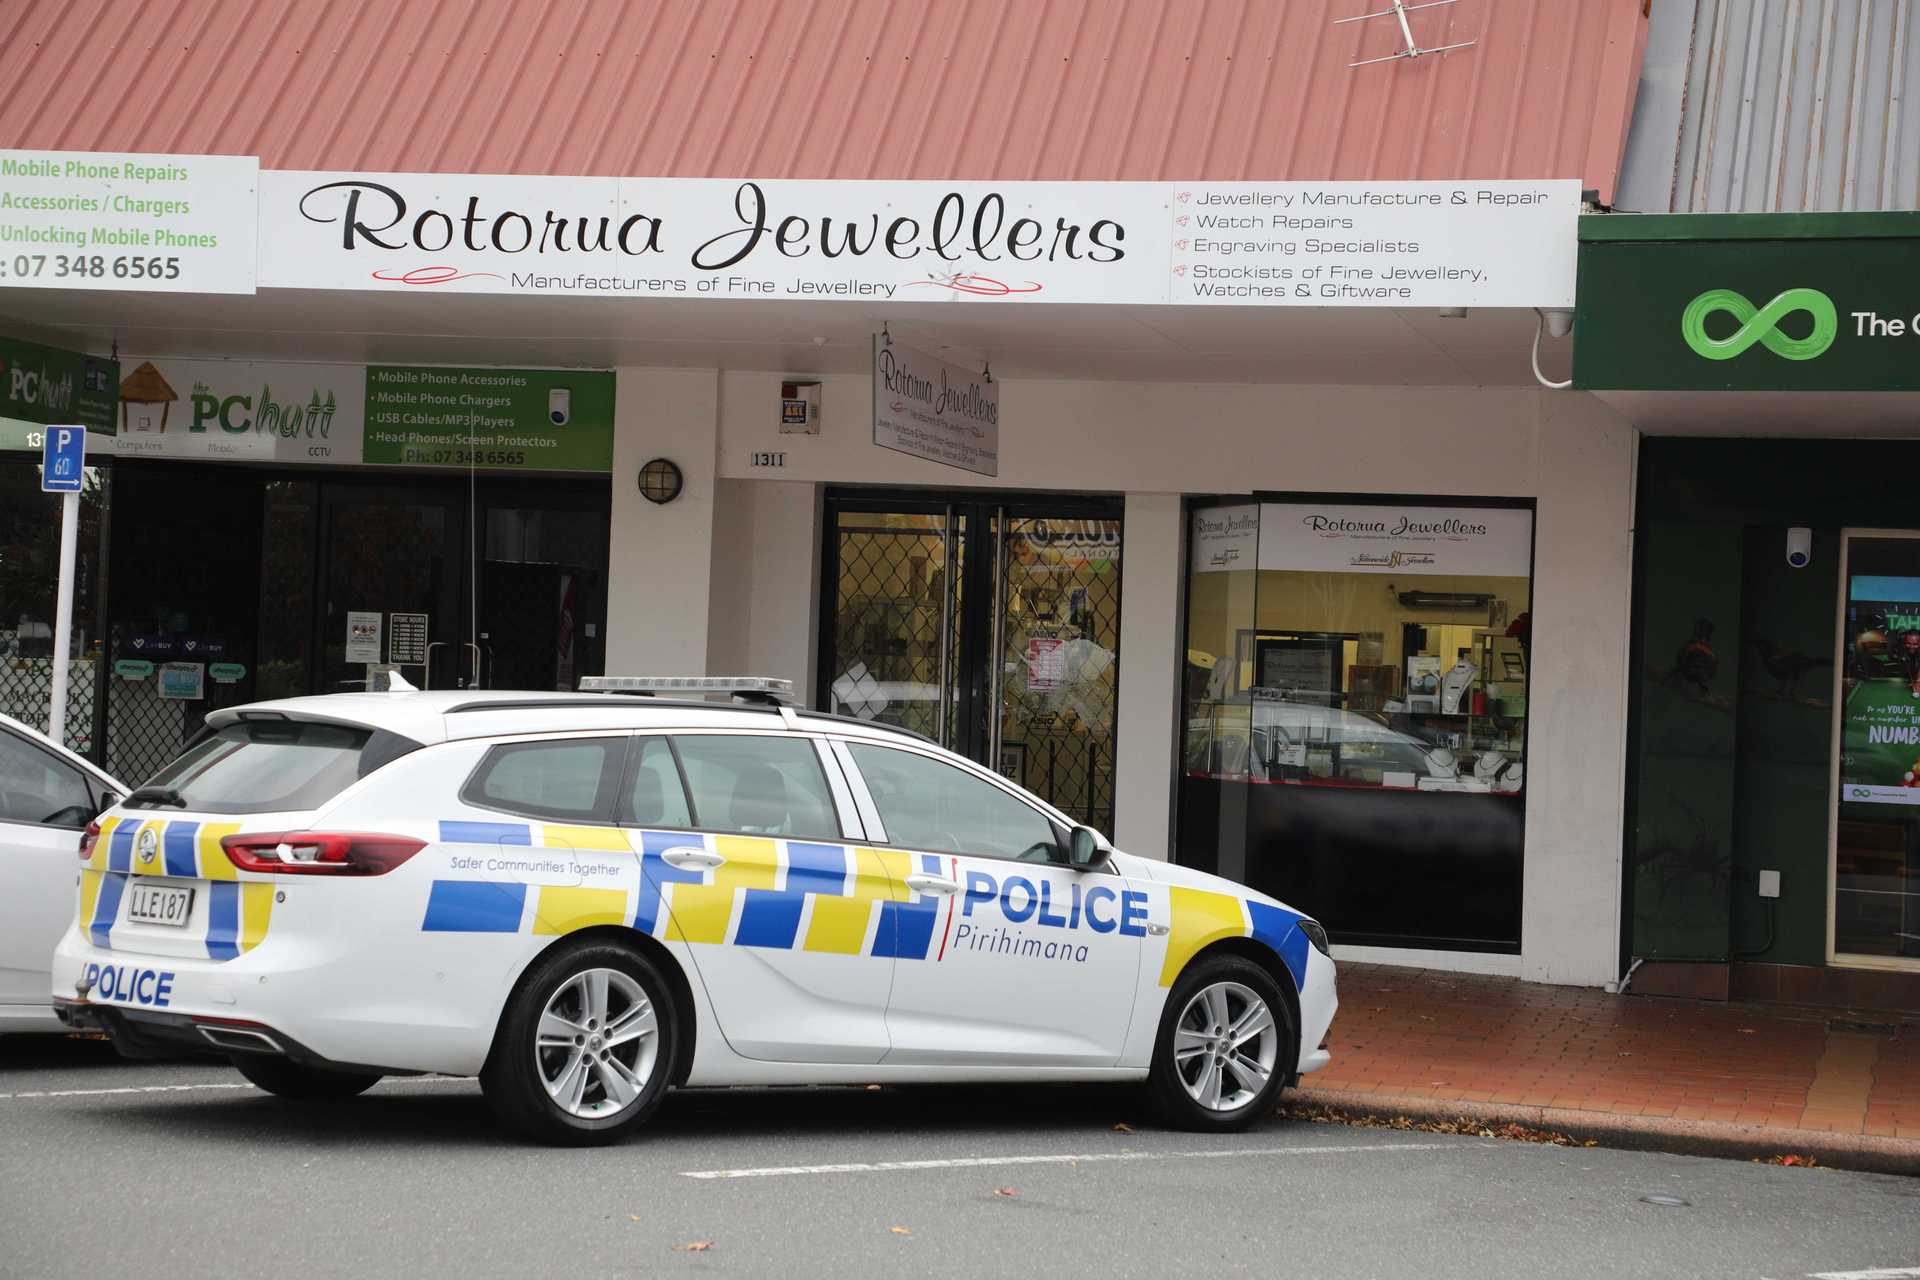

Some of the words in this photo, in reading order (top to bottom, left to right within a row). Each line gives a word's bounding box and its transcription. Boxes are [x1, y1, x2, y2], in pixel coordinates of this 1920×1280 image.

[2, 159, 60, 177] Mobile
[65, 161, 120, 179] Phone
[124, 163, 188, 184] Repairs
[1, 192, 98, 211] Accessories
[113, 196, 190, 217] Chargers
[1196, 191, 1294, 208] Jewellery
[1302, 191, 1442, 206] Manufacture
[1450, 191, 1467, 205] &
[1477, 191, 1549, 208] Repair
[299, 181, 665, 256] Rotorua
[691, 182, 1126, 271] Jewellers
[1196, 215, 1264, 230] Watch
[1272, 215, 1354, 231] Repairs
[1, 225, 87, 248] Unlocking
[91, 227, 149, 246] Mobile
[155, 229, 217, 248] Phones
[1194, 239, 1297, 255] Engraving
[1305, 239, 1420, 254] Specialists
[14, 255, 47, 278] 07
[54, 255, 105, 278] 348
[112, 256, 181, 279] 6565
[1193, 264, 1293, 280] Stockists
[1302, 264, 1323, 280] of
[1330, 265, 1374, 280] Fine
[1381, 266, 1488, 283] Jewellery,
[511, 272, 687, 292] Manufacturers
[696, 277, 720, 293] of
[728, 277, 776, 295] Fine
[786, 278, 897, 299] Jewellery
[1193, 282, 1286, 298] Watches
[1294, 284, 1312, 298] &
[1320, 284, 1412, 299] Giftware
[1851, 312, 1906, 337] The
[378, 372, 418, 384] Mobile
[421, 373, 458, 385] Phone
[460, 374, 527, 387] Accessories
[879, 349, 932, 404] Rotorua
[935, 368, 997, 425] Jewellers
[189, 394, 252, 434] PC
[255, 381, 336, 439] hutt
[377, 392, 417, 404] Mobile
[420, 393, 457, 405] Phone
[459, 394, 511, 408] Chargers
[377, 413, 400, 424] USB
[402, 413, 471, 426] Cables/MP3
[473, 415, 515, 429] Players
[58, 430, 72, 453] P
[376, 432, 405, 443] Head
[408, 433, 494, 446] Phones/Screen
[497, 436, 557, 448] Protectors
[308, 446, 332, 457] CCTV
[406, 449, 431, 463] Ph:
[433, 451, 451, 463] 07
[456, 451, 482, 463] 348
[487, 451, 525, 464] 6565
[755, 453, 783, 466] 1311
[55, 457, 70, 475] 60
[1303, 514, 1385, 534] Rotorua
[1391, 516, 1486, 536] Jewellers
[1887, 704, 1916, 715] YOU'RE
[1869, 725, 1920, 744] NUMB
[450, 856, 482, 870] Safer
[487, 858, 564, 873] Communities
[569, 862, 620, 876] Together
[131, 891, 186, 920] LLE187
[962, 870, 1149, 938] POLICE
[954, 924, 1089, 963] Pirihimana
[86, 963, 175, 1007] POLICE
